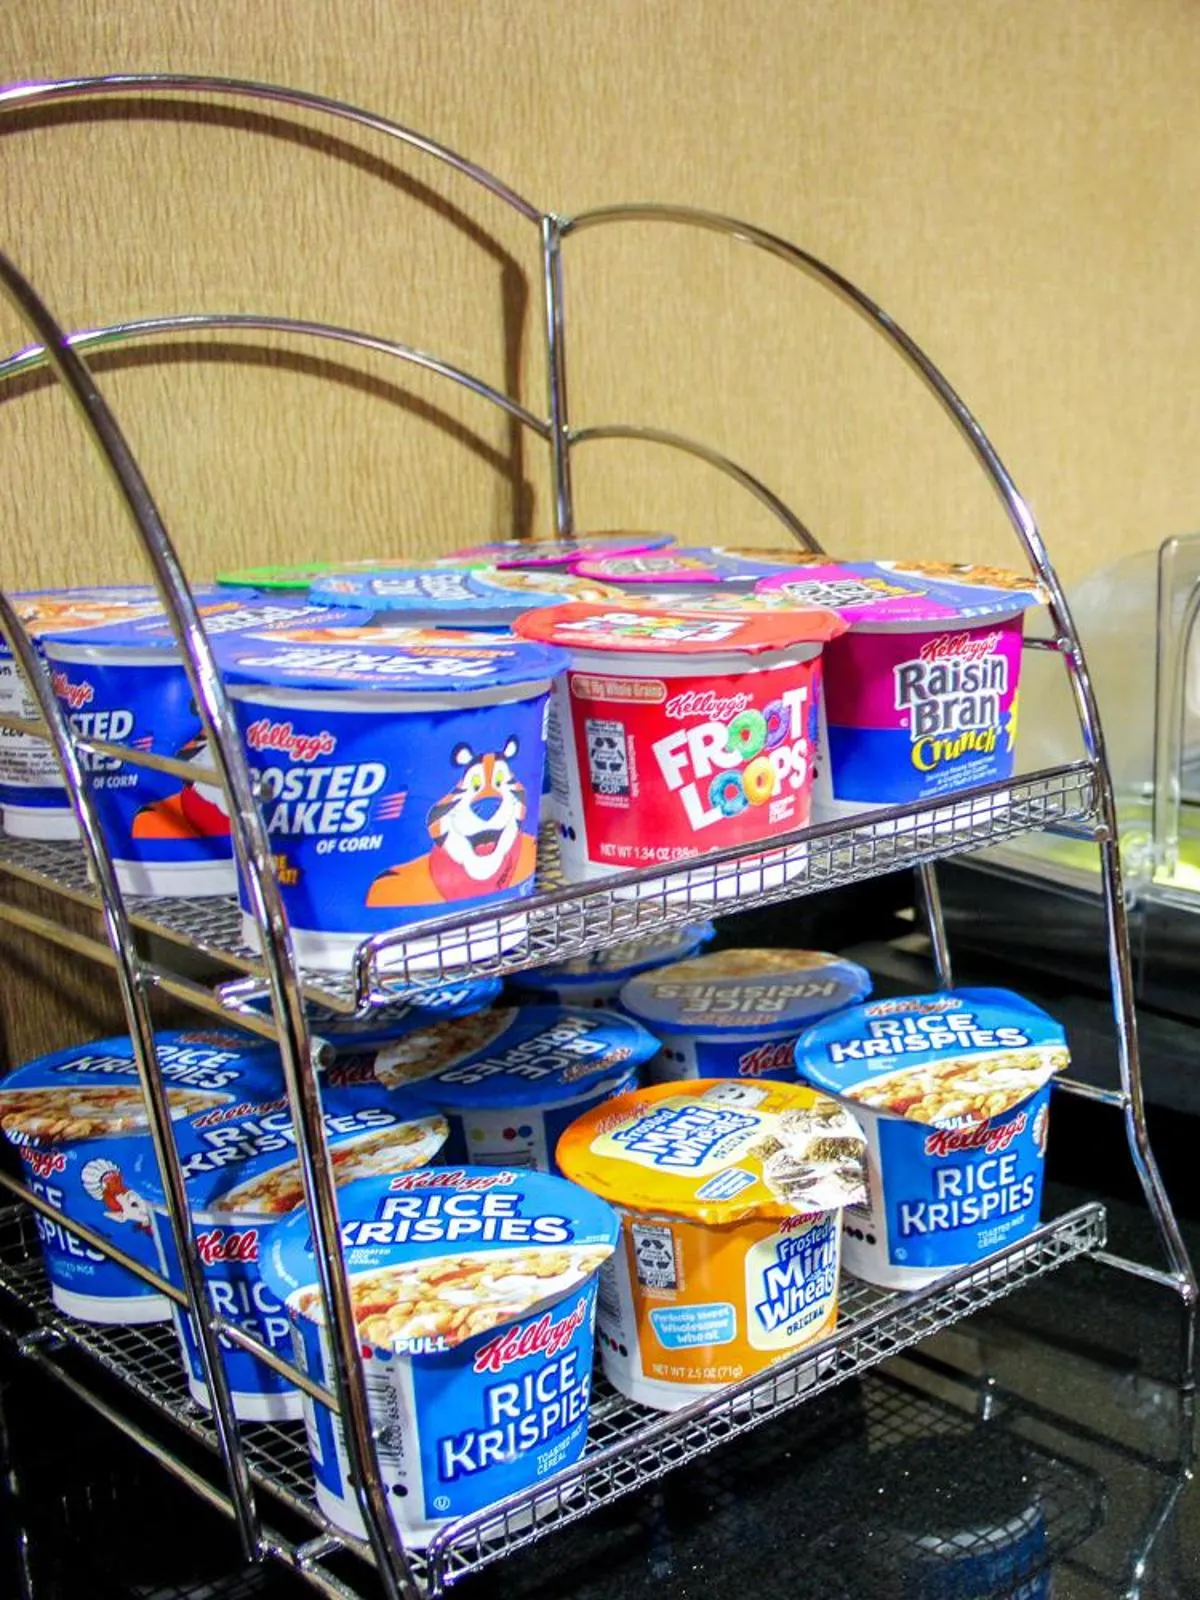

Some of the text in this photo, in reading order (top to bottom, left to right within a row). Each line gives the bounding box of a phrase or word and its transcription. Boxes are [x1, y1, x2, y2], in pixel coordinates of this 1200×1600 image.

[920, 632, 998, 662] Kellogg's
[895, 656, 1006, 708] Raisin
[665, 690, 753, 720] Kellogg's
[914, 694, 996, 737] Bran
[247, 719, 338, 762] Kellogg's
[911, 728, 996, 771] Crunch
[250, 763, 387, 801] OSTED
[267, 798, 370, 836] AKES
[316, 835, 383, 855] OF CORN
[656, 981, 838, 998] KRISPIES
[682, 998, 785, 1012] RICE
[830, 1028, 1028, 1062] KRISPIES
[870, 1013, 977, 1039] RICE
[439, 1016, 599, 1085] KRISPIES
[505, 1035, 607, 1080] RICE
[203, 1113, 295, 1149] RIC
[633, 1107, 722, 1155] Mini
[924, 1112, 1029, 1157] Kellogg's
[389, 1171, 518, 1191] Kellogg's
[937, 1153, 1018, 1200] RICE
[381, 1194, 517, 1220] RICE
[902, 1175, 1034, 1235] KRISPIES
[338, 1216, 570, 1245] KRISPIES
[766, 1230, 837, 1301] Mini
[208, 1280, 282, 1314] RIC
[394, 1335, 449, 1354] PULL
[473, 1297, 588, 1374] Kellogg's
[489, 1351, 578, 1425] RICE
[443, 1373, 590, 1478] KRISPIES
[536, 1436, 570, 1465] TOASTED
[537, 1451, 566, 1475] CEREAL
